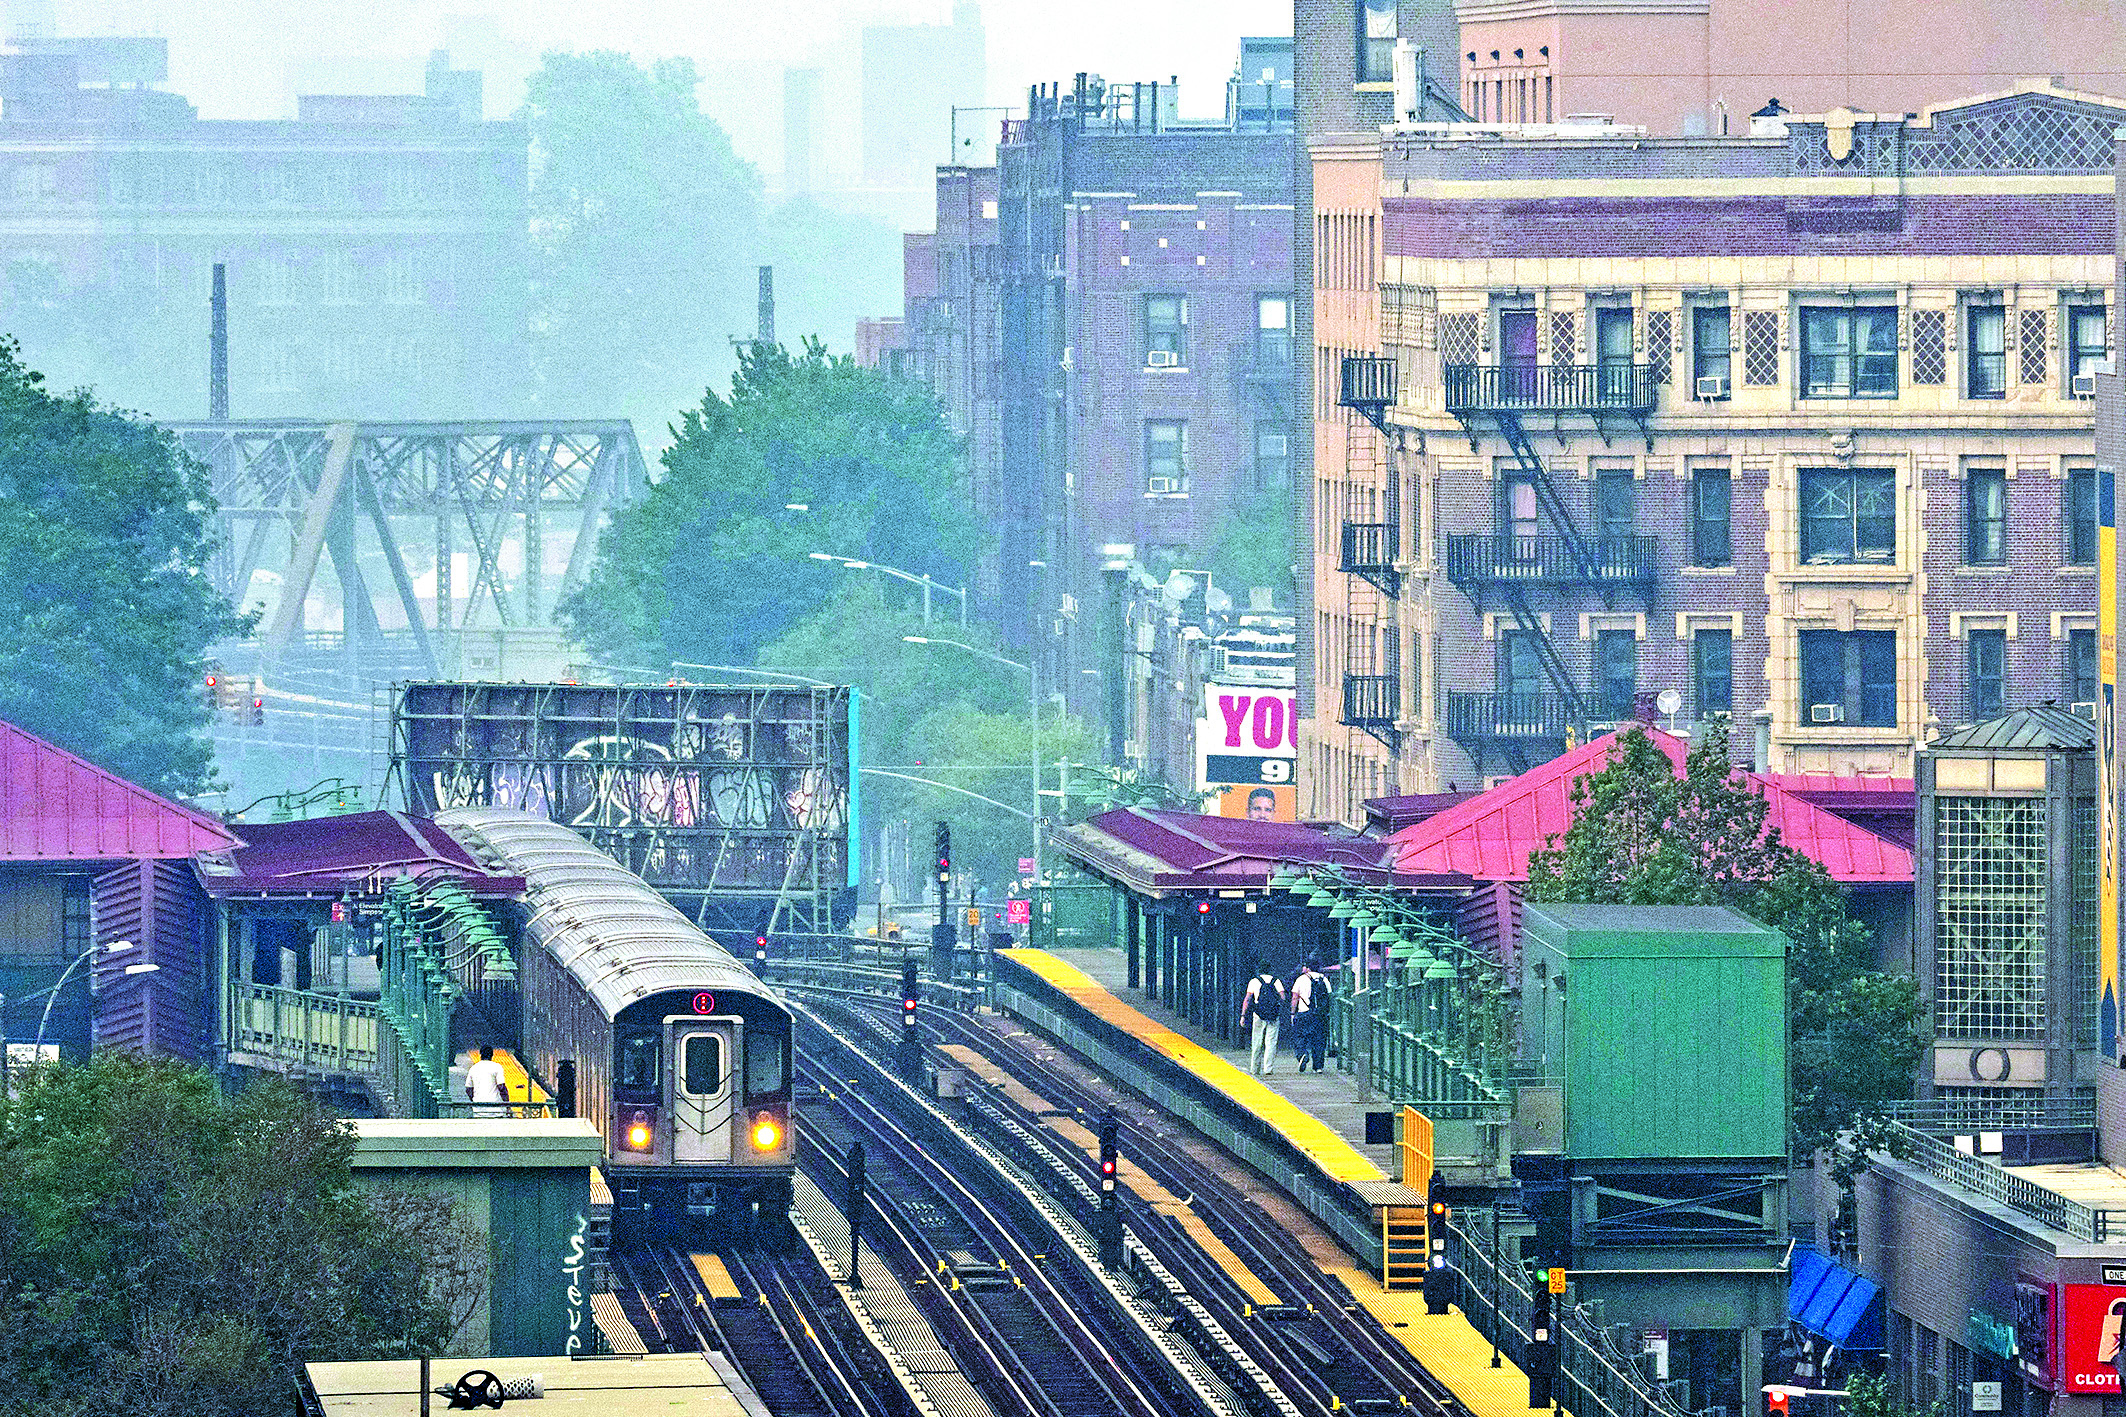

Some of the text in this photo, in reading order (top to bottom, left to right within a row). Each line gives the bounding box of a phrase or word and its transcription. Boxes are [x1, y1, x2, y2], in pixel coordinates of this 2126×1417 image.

[1261, 760, 1297, 782] 9
[2109, 1271, 2125, 1280] ONE
[1551, 1280, 1563, 1290] 25
